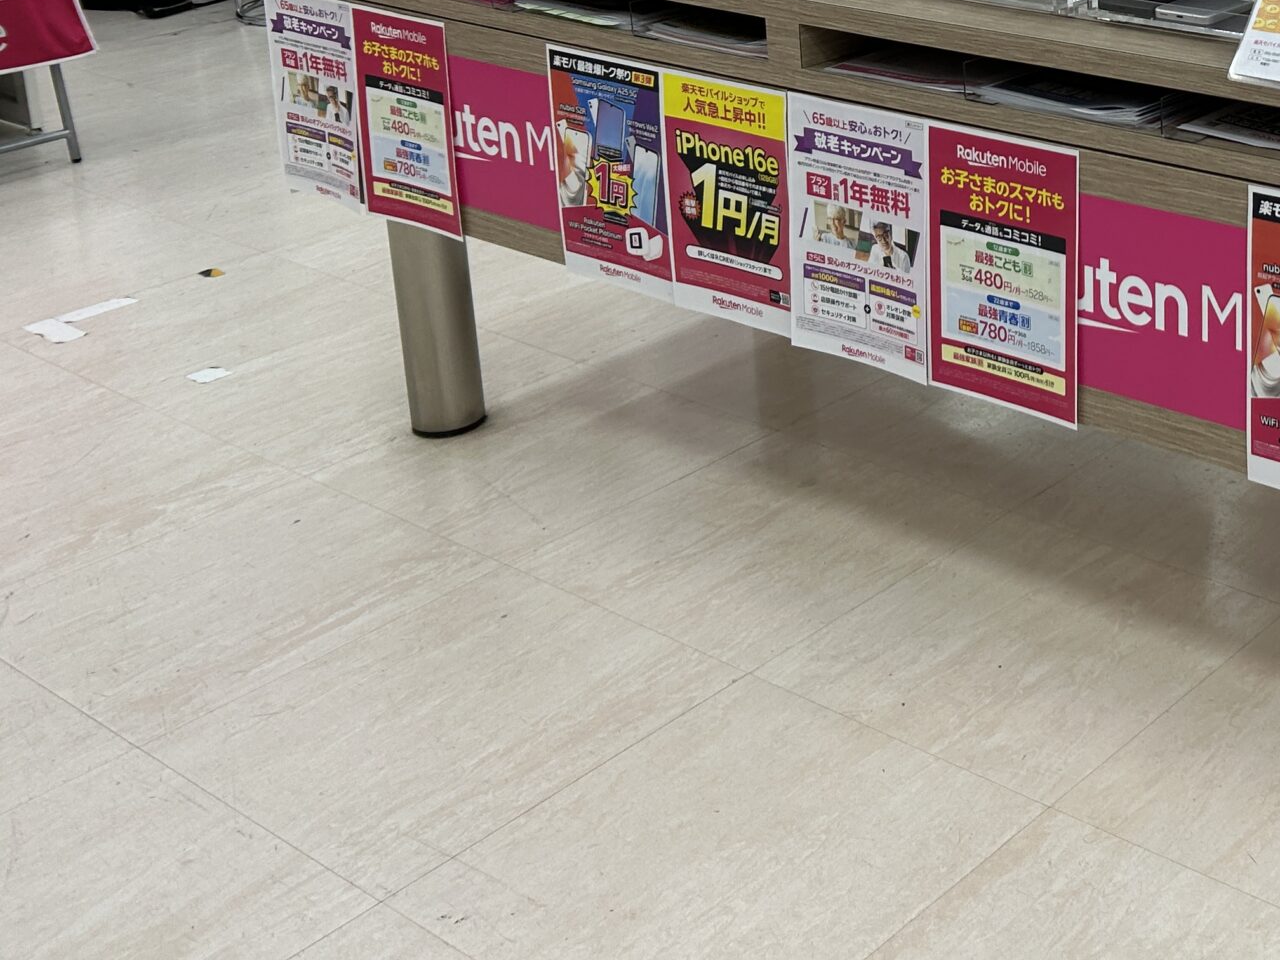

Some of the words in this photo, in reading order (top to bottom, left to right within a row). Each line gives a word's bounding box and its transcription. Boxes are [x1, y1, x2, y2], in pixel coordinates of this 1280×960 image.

[283, 15, 339, 40] 敬老キャンペーン
[371, 20, 402, 40] Rakuten
[402, 29, 427, 45] Mobile
[302, 51, 348, 83] 1年無料
[363, 40, 440, 72] お子さまのスマホも
[383, 60, 421, 82] おトクに!
[681, 82, 766, 110] 楽天モバイルショップで
[682, 97, 767, 130] 人気急上昇中!!
[675, 128, 745, 169] iPhone
[744, 146, 779, 176] 16e
[814, 131, 902, 165] 敬老キャンペーン
[957, 144, 1007, 168] Rakuten
[1008, 155, 1047, 177] Mobile
[594, 161, 627, 207] 1円
[809, 175, 829, 187] プラン
[812, 185, 827, 196] 料金
[940, 167, 1065, 210] お子さまのスマホも
[690, 161, 781, 246] 1円/月
[840, 177, 911, 219] 1年無料
[969, 193, 1031, 224] おトクに!
[599, 263, 624, 279] Rakuten
[623, 270, 642, 283] Mobile
[974, 249, 1034, 278] 最強こども割
[712, 294, 742, 311] Rakuten
[741, 302, 764, 318] Mobile
[977, 302, 1032, 331] 最強青春割
[842, 344, 868, 360] Rakuten
[867, 350, 886, 365] Mobile
[1260, 415, 1279, 429] WiFi
